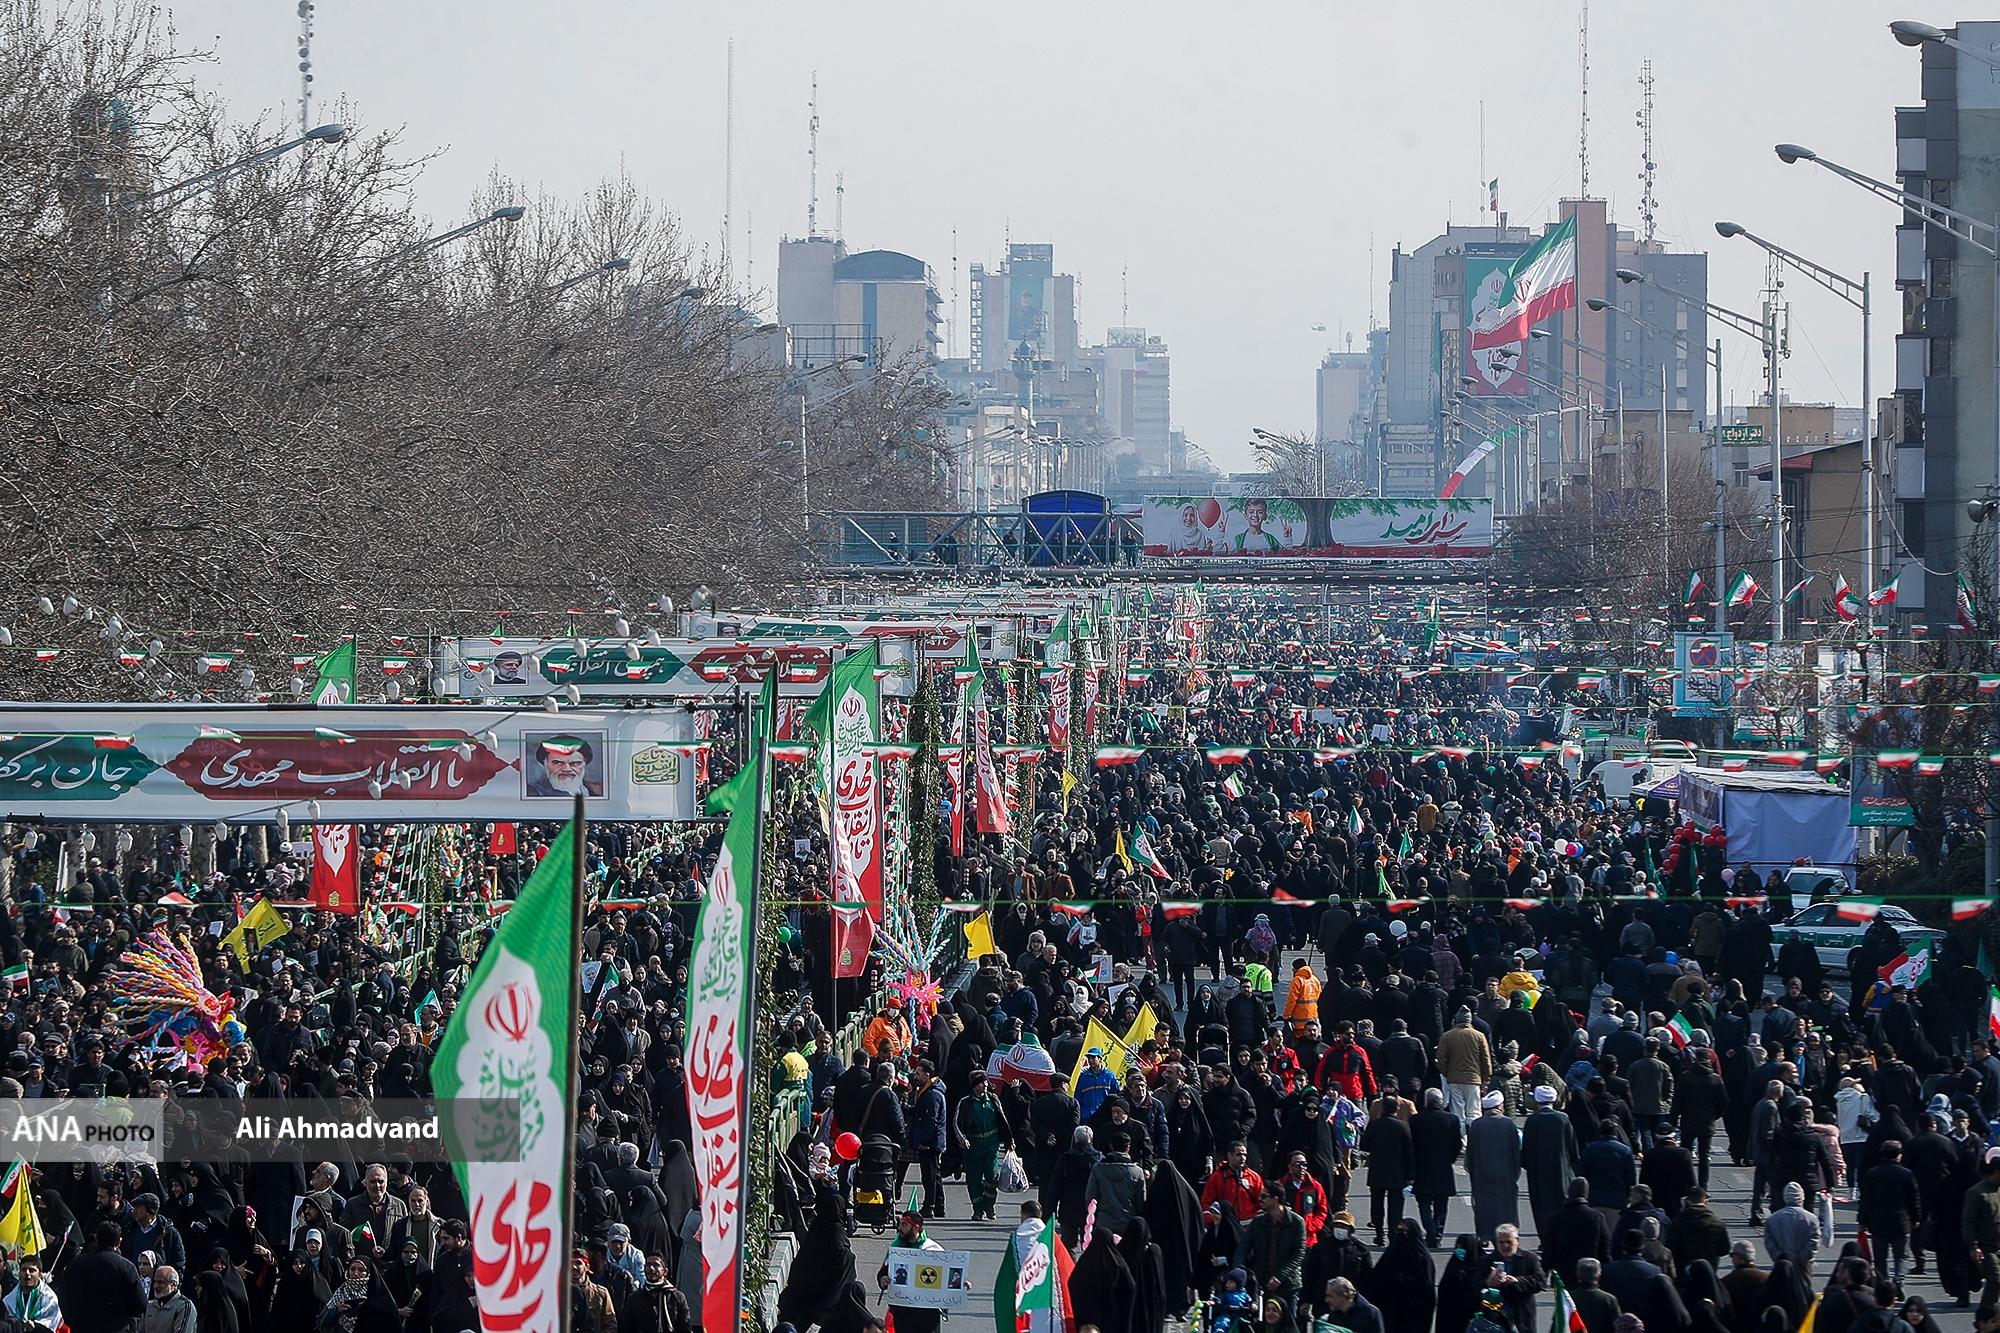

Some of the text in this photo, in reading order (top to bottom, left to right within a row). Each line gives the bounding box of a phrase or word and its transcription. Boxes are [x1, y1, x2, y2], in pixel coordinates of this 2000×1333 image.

[1380, 511, 1434, 538] امید
[51, 753, 132, 791] جان
[200, 749, 294, 789] مهدی
[836, 760, 872, 801] مهدی
[470, 1179, 552, 1301] مهدی
